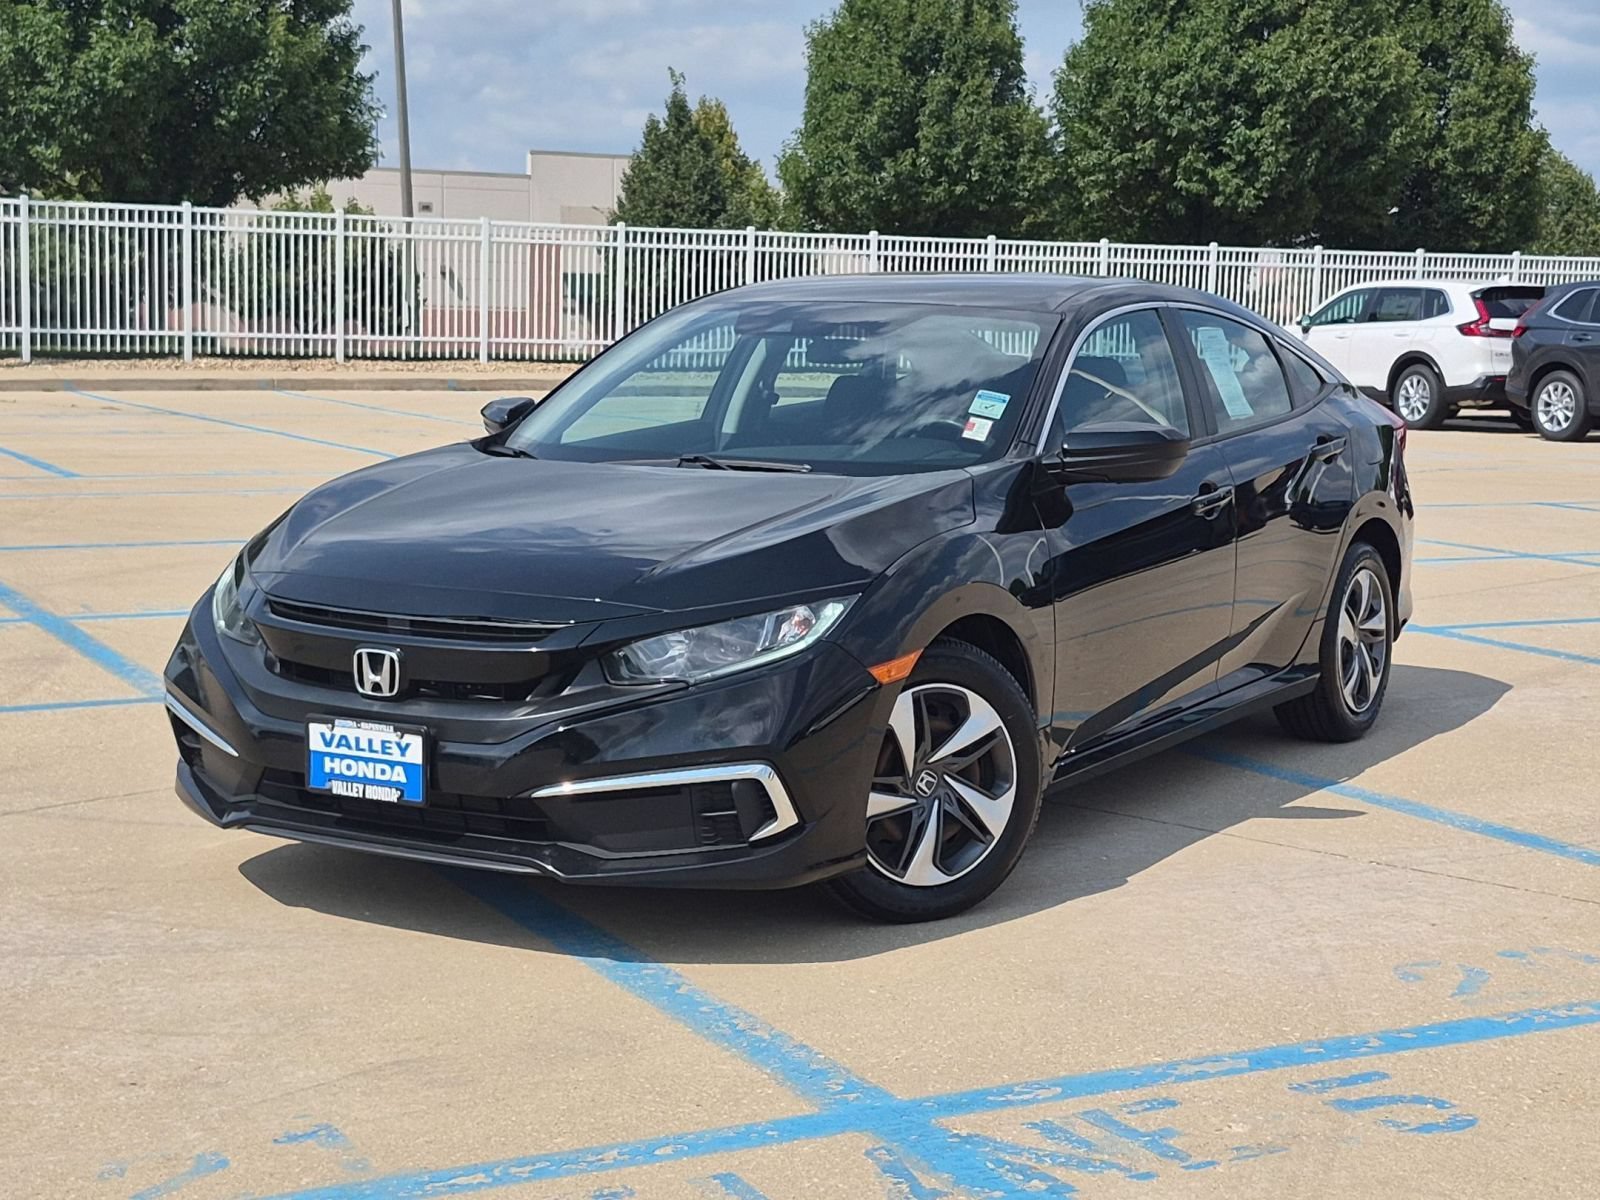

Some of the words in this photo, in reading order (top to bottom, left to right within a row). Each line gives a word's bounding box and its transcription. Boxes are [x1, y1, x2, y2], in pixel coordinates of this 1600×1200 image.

[320, 732, 411, 757] VALLEY
[323, 757, 407, 783] HONDA
[331, 780, 364, 798] VALLEY
